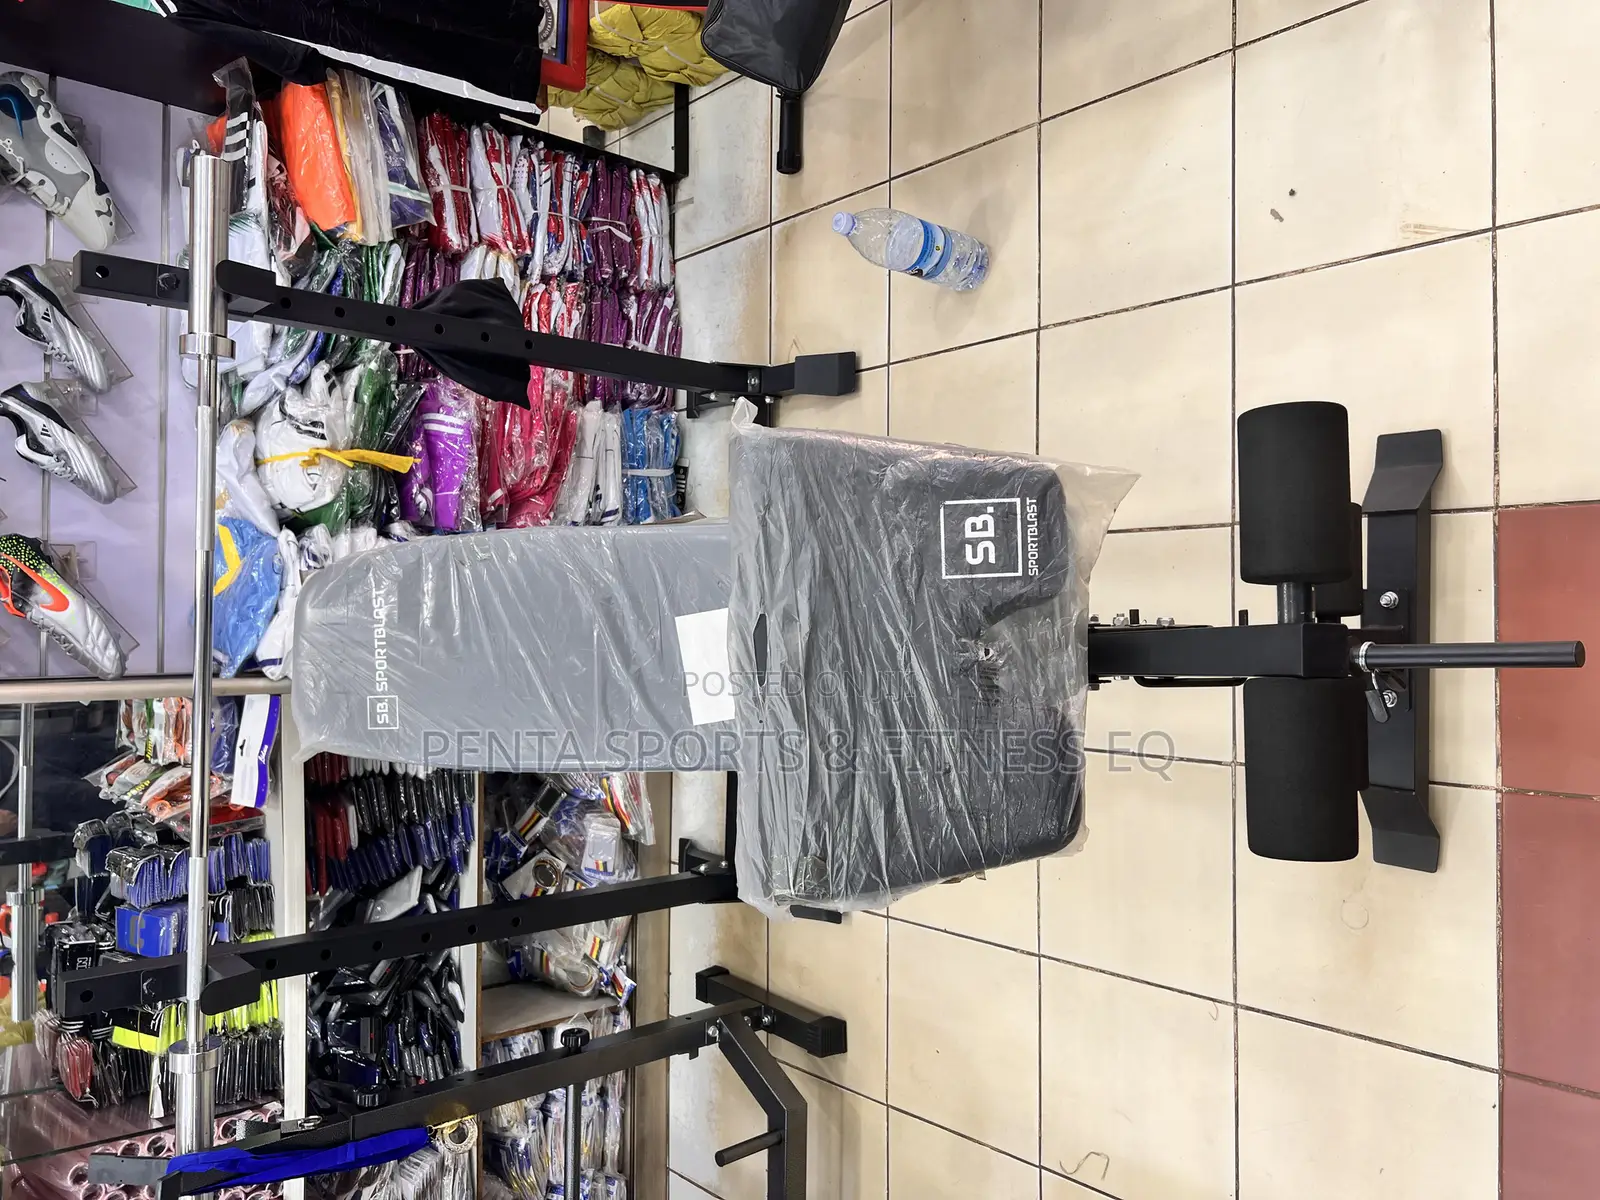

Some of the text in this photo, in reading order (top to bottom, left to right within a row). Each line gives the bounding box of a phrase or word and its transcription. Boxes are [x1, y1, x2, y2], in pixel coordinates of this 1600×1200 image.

[964, 506, 996, 565] SB.
[1026, 497, 1039, 576] SPORTBLAST
[376, 699, 388, 724] SB.
